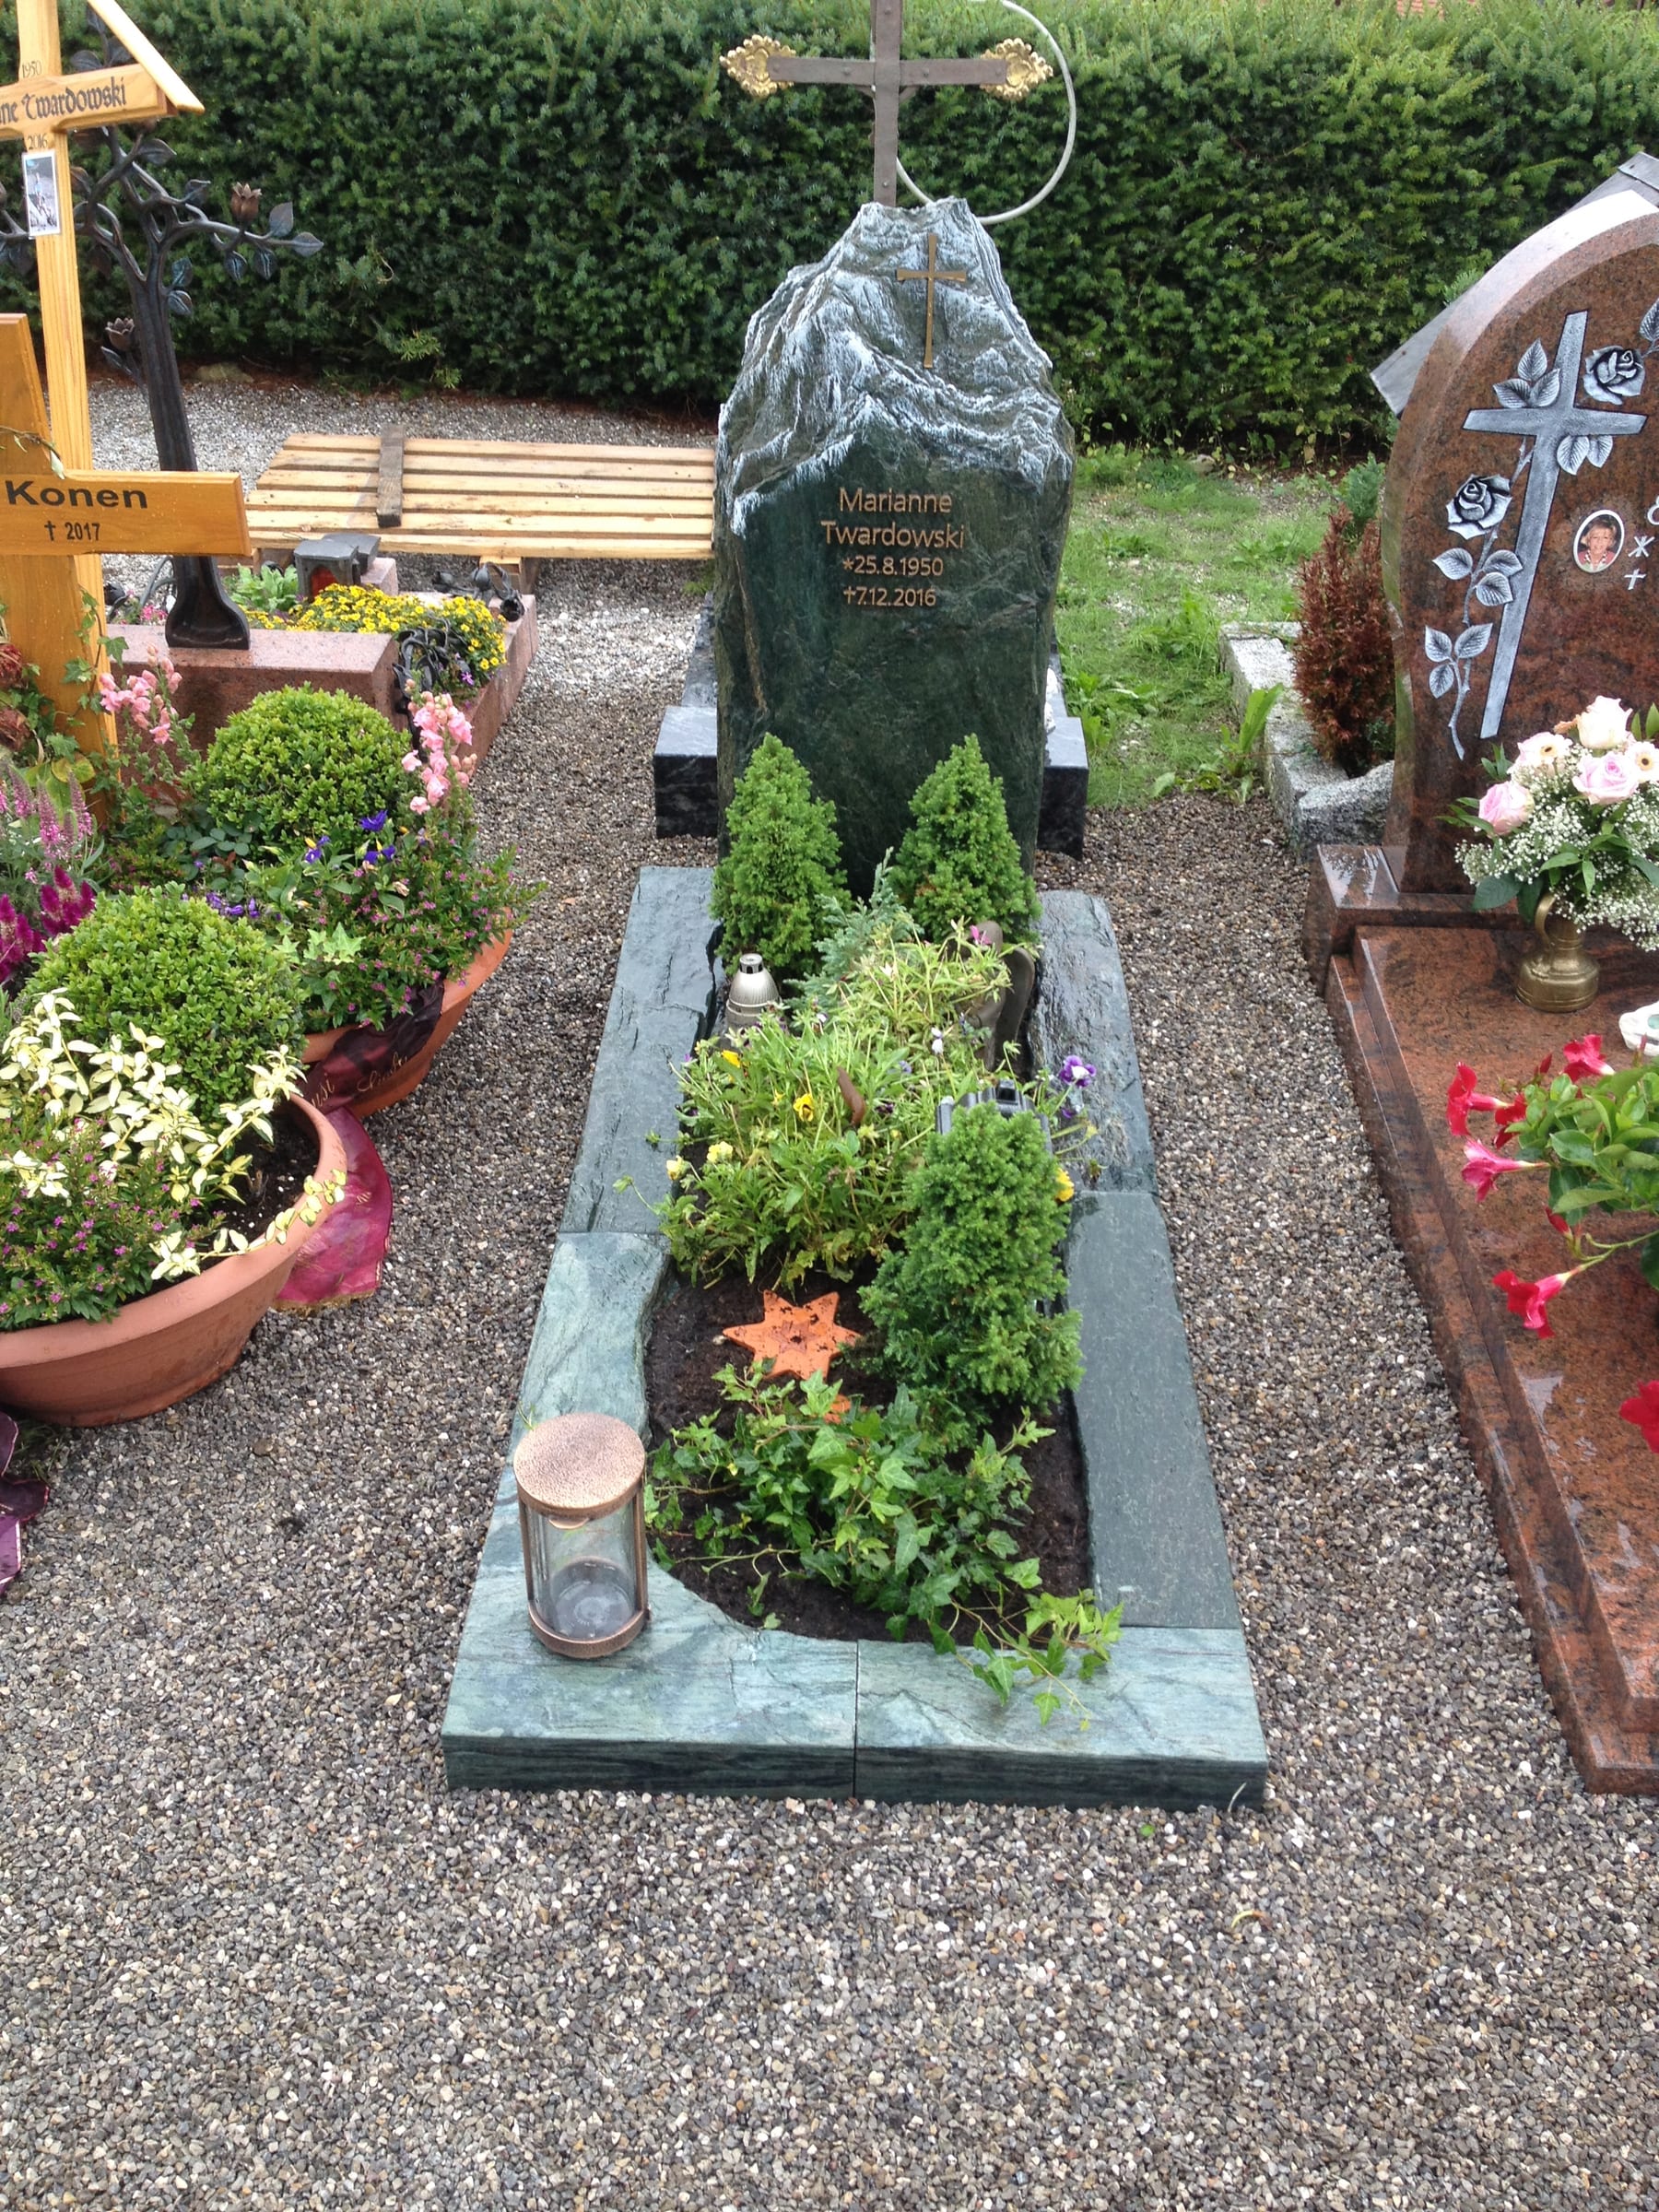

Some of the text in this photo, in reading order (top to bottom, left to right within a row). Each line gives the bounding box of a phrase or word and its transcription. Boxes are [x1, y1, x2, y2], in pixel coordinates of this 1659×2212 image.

[0, 76, 126, 125] ne Twardowski
[6, 480, 147, 509] Konen
[839, 487, 952, 513] Marianne
[65, 522, 100, 541] 2017
[820, 520, 965, 548] Twardowski
